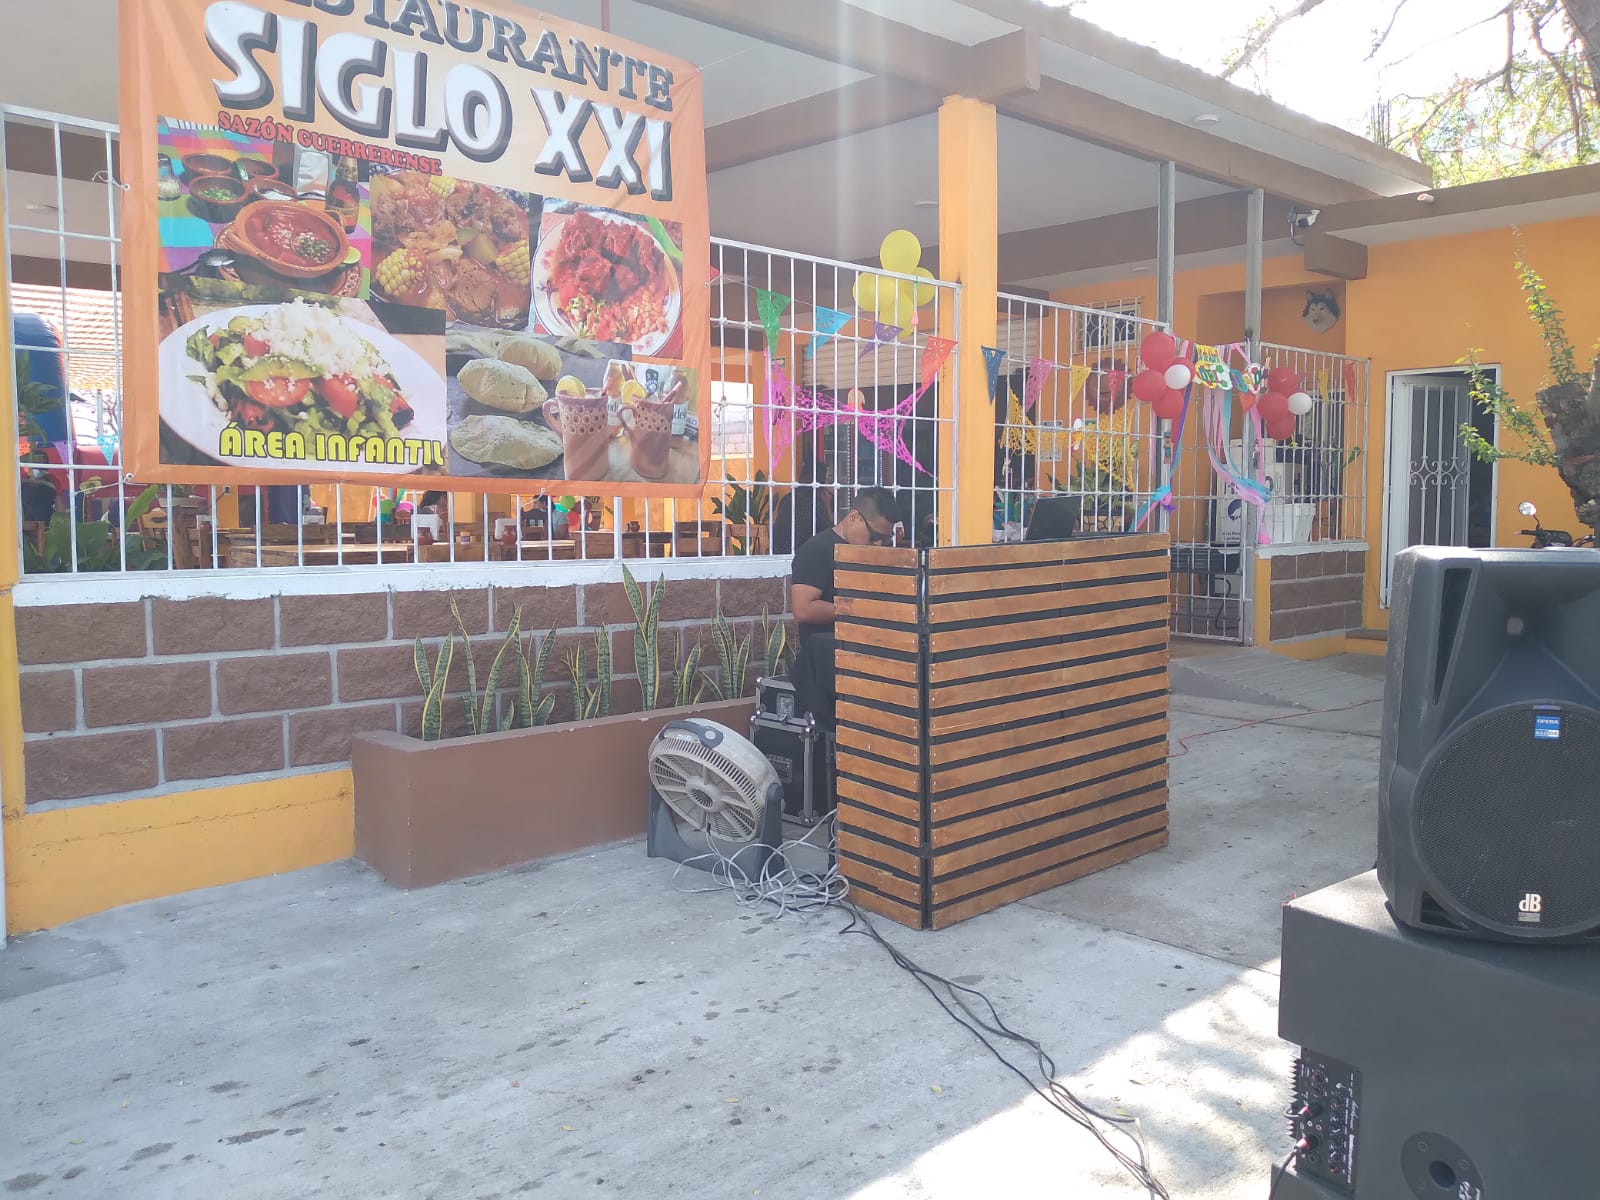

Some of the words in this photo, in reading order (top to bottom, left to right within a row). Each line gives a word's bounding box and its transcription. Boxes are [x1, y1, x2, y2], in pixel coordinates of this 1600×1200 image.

[204, 0, 513, 163] SIGLO
[530, 87, 673, 202] XXI
[218, 111, 294, 143] SAZÓN
[296, 130, 443, 176] GUERRERENSE
[219, 422, 306, 460] ÁREA
[315, 432, 445, 466] INFANTIL
[1519, 893, 1542, 912] dB
